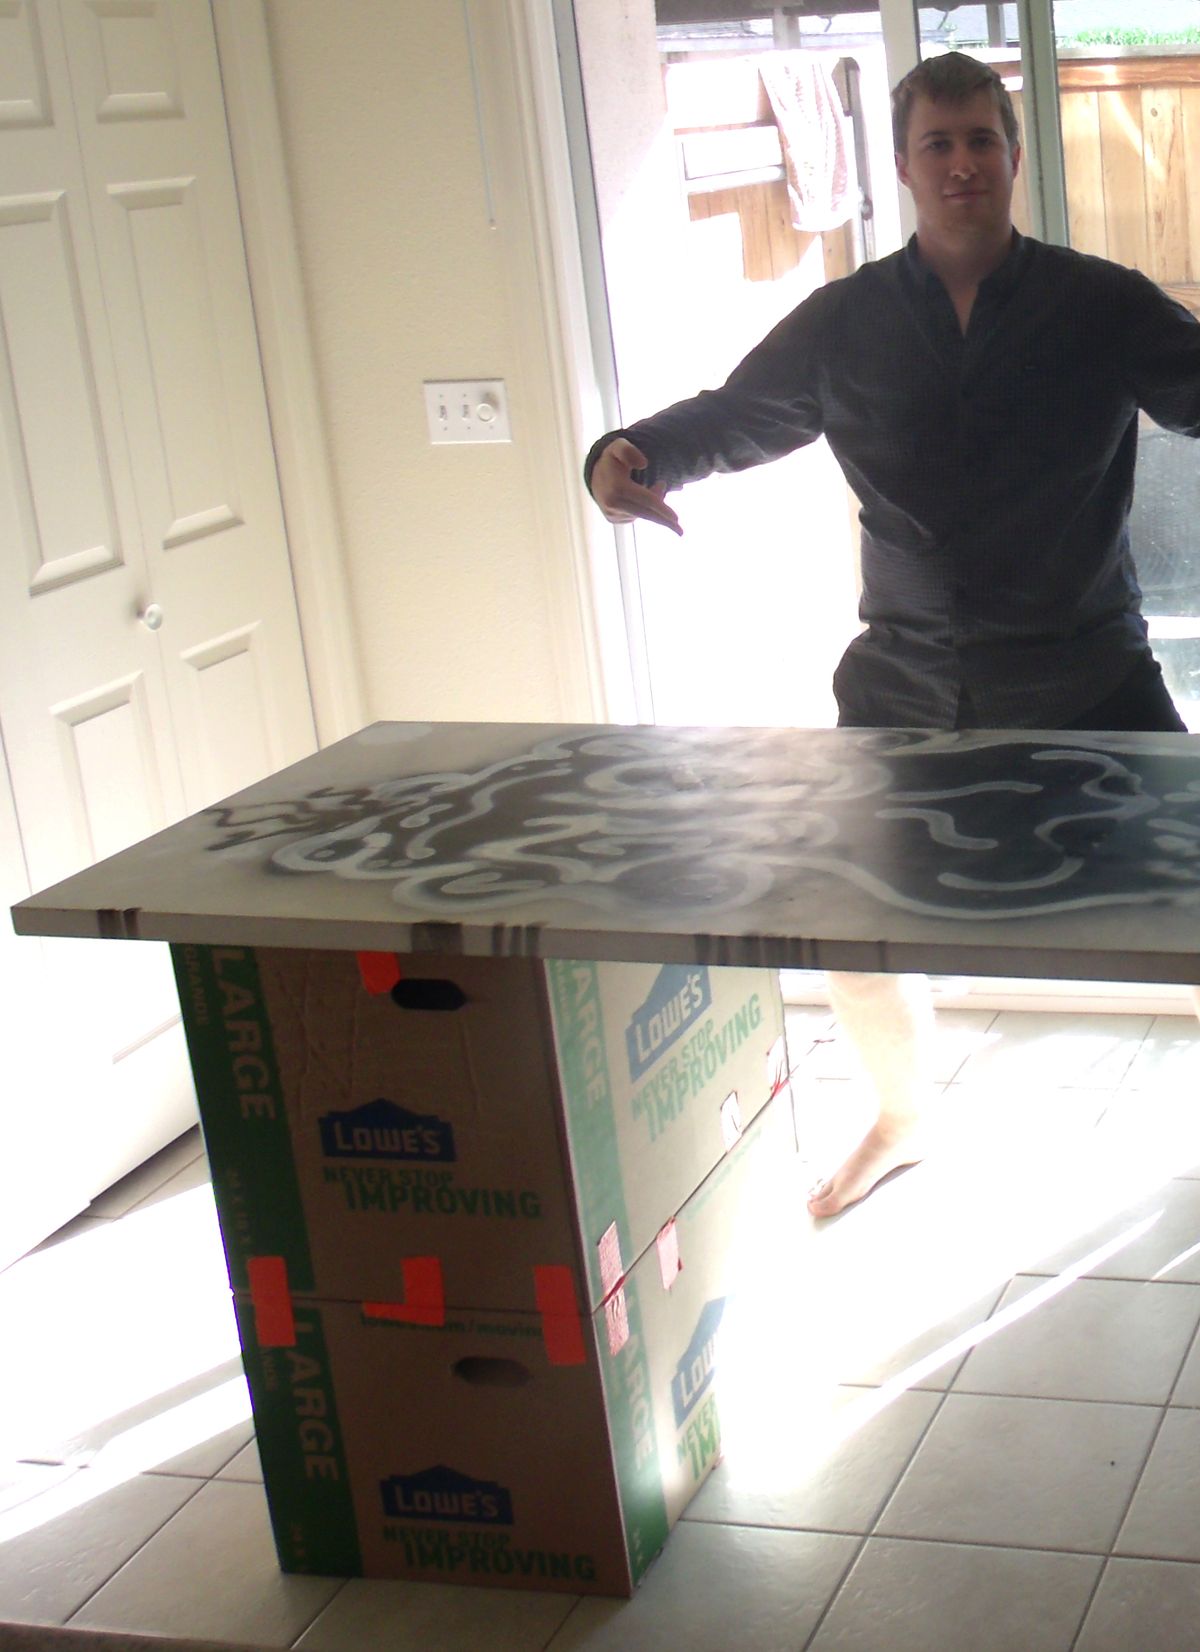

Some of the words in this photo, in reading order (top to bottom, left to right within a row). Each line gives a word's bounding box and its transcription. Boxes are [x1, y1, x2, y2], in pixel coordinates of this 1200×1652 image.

[212, 949, 277, 1121] LARGE
[571, 961, 607, 1112] ARGE
[634, 973, 704, 1063] LOWE'S
[632, 1057, 679, 1121] NEVER
[682, 1017, 714, 1066] STOP
[643, 993, 763, 1144] IMPROVING
[333, 1121, 441, 1155] LOWE'S
[322, 1165, 395, 1187] NEVER
[399, 1167, 455, 1188] STOP
[344, 1180, 542, 1220] IMPROVING
[393, 1484, 499, 1518] LOWE'S
[382, 1525, 450, 1546] NEVER
[457, 1527, 511, 1549] STOP
[403, 1541, 598, 1582] IMPROVING
